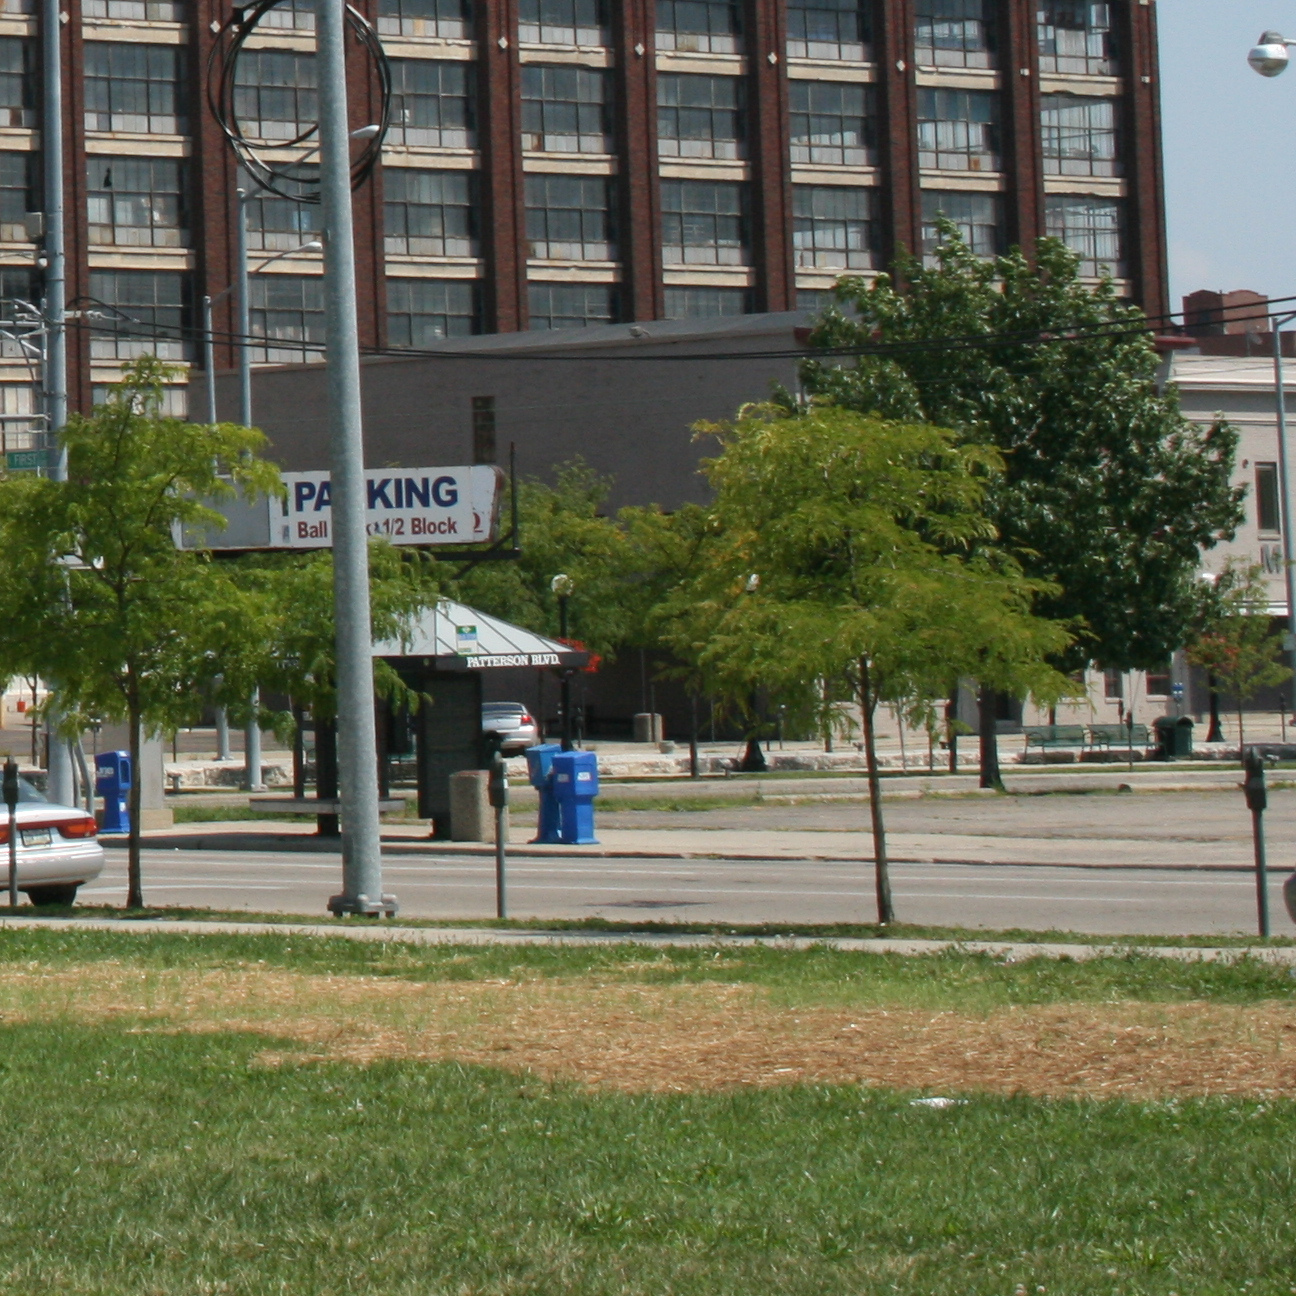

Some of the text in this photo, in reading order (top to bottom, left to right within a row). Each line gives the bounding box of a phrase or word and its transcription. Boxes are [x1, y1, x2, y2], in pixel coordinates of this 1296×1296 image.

[294, 476, 458, 512] PAKING
[297, 520, 328, 539] Ball
[383, 518, 405, 536] 1/2
[411, 517, 458, 535] Block
[466, 654, 529, 668] PATTERSON
